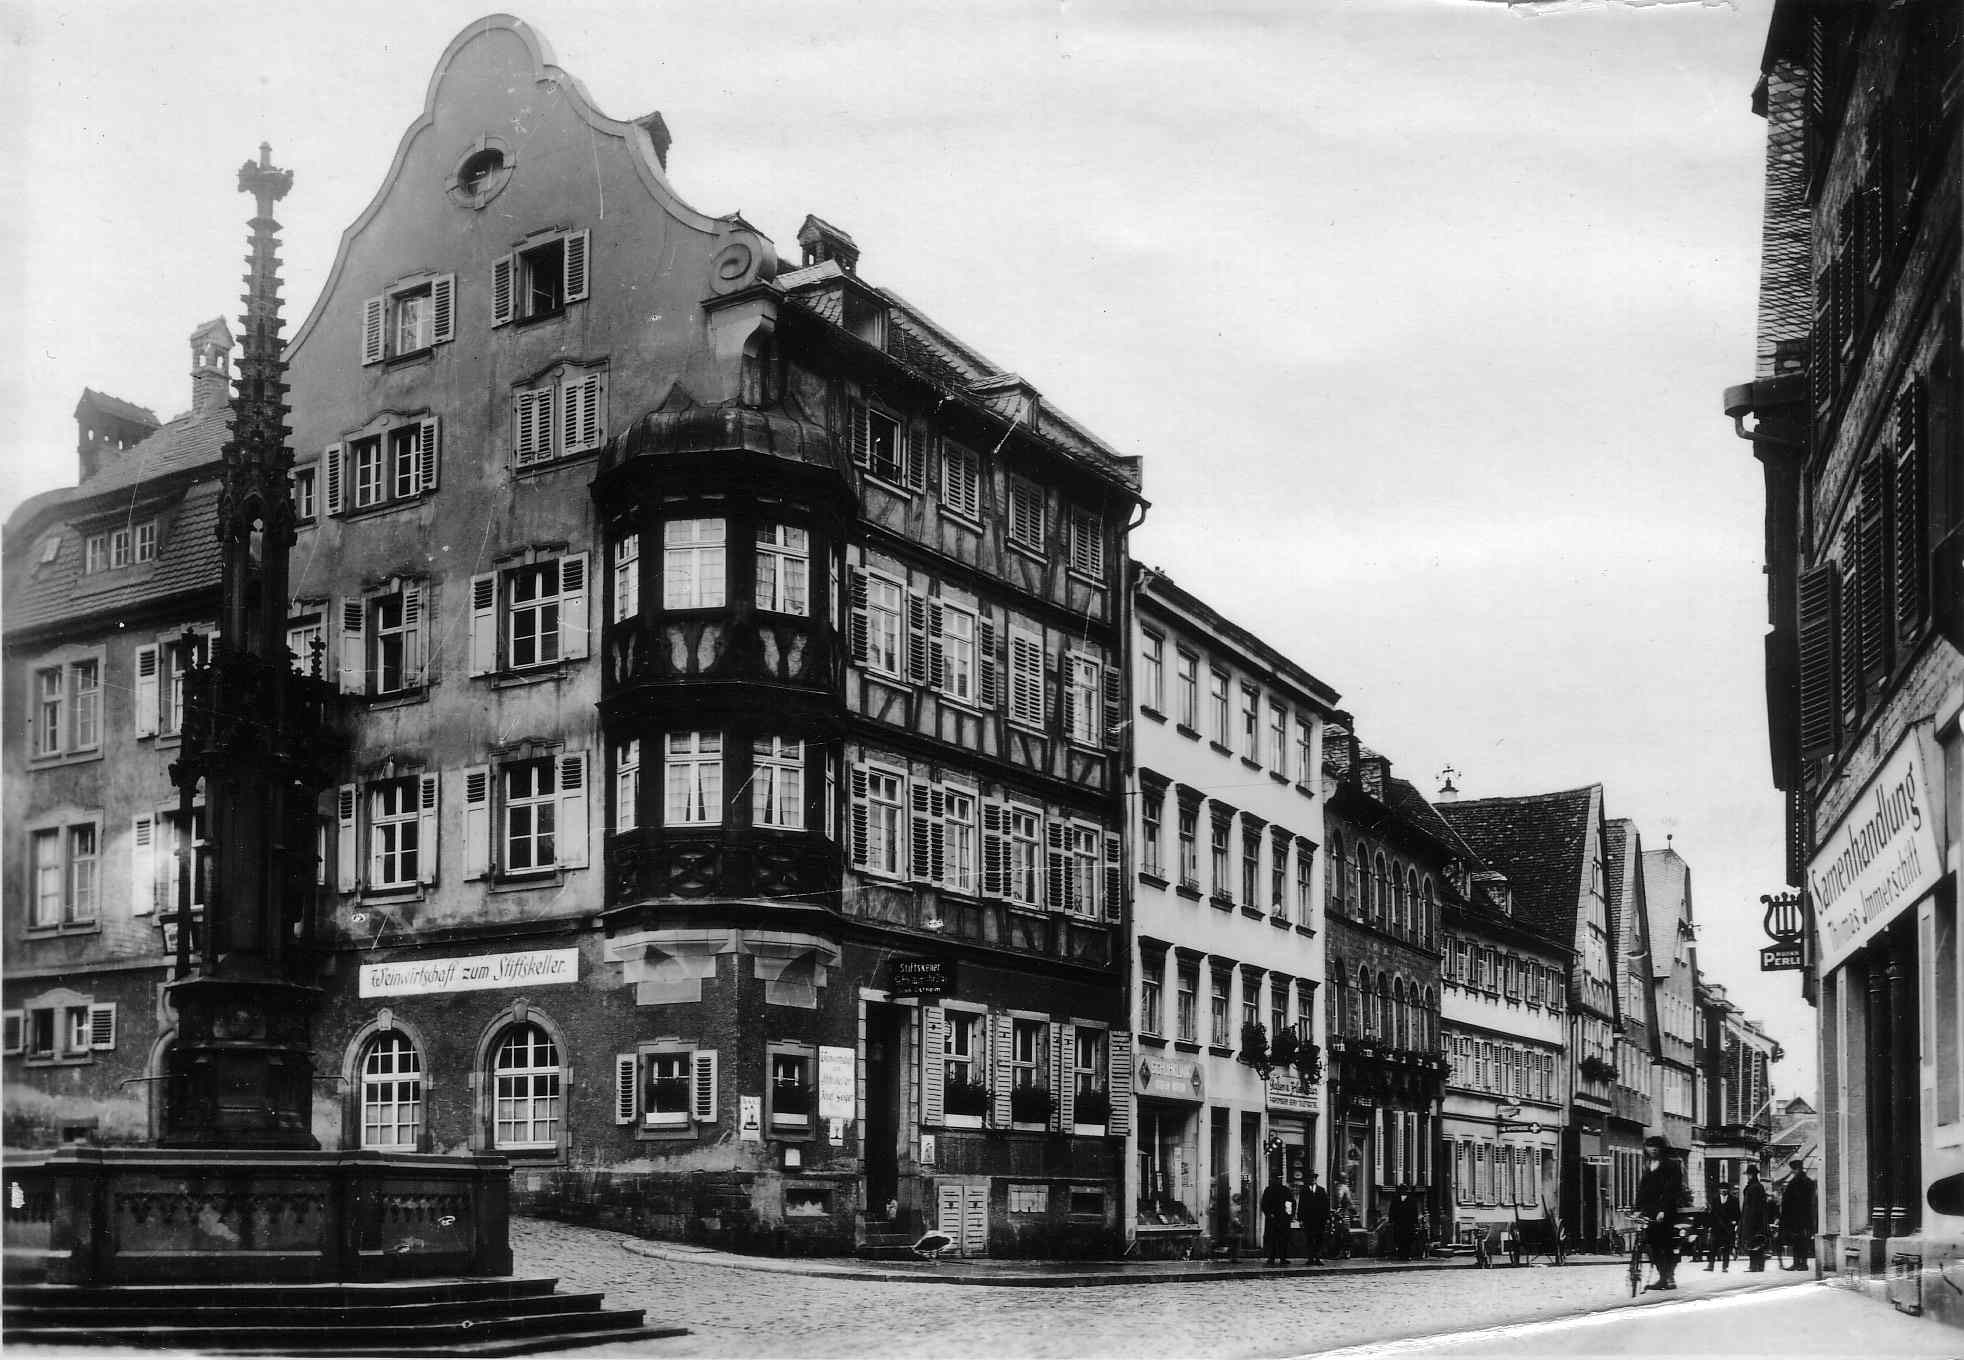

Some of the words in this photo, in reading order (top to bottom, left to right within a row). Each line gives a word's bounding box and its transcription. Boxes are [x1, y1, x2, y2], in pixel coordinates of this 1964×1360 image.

[1811, 762, 1922, 916] Samenhandlung
[371, 959, 459, 988] Weinwirtschaft
[462, 966, 489, 980] zum
